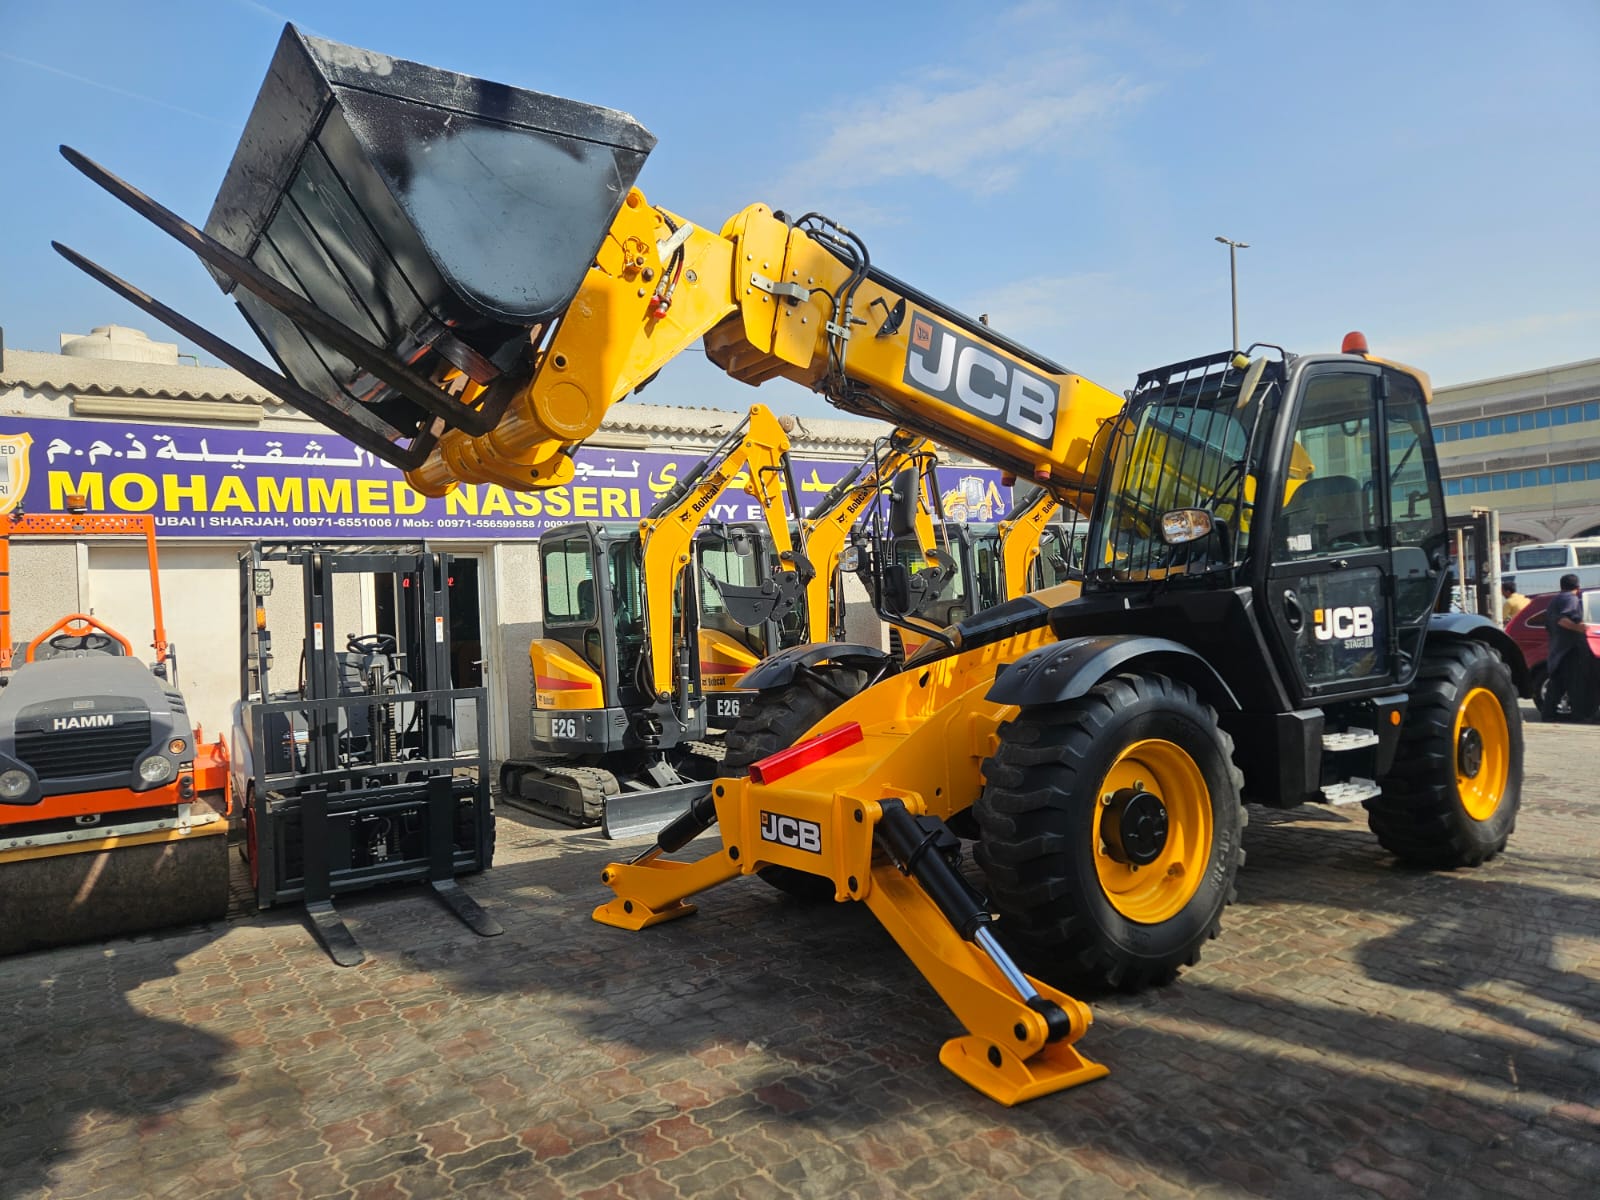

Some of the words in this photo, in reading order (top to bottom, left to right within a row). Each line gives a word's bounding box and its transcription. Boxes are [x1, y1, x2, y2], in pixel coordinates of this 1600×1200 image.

[909, 332, 1055, 440] JCB
[48, 471, 427, 515] MOHAMMED
[446, 483, 641, 518] NASSERI
[692, 485, 720, 512] Bobcat
[155, 516, 196, 527] UBAI
[209, 517, 289, 528] SHARJAH,
[292, 518, 392, 528] 00971-6551006
[403, 519, 434, 528] Mob:
[437, 519, 535, 529] 00971-556599558
[1314, 606, 1374, 640] JCB
[717, 699, 740, 717] E26
[53, 714, 114, 731] HAMM
[551, 718, 576, 738] E26
[761, 814, 821, 852] JCB
